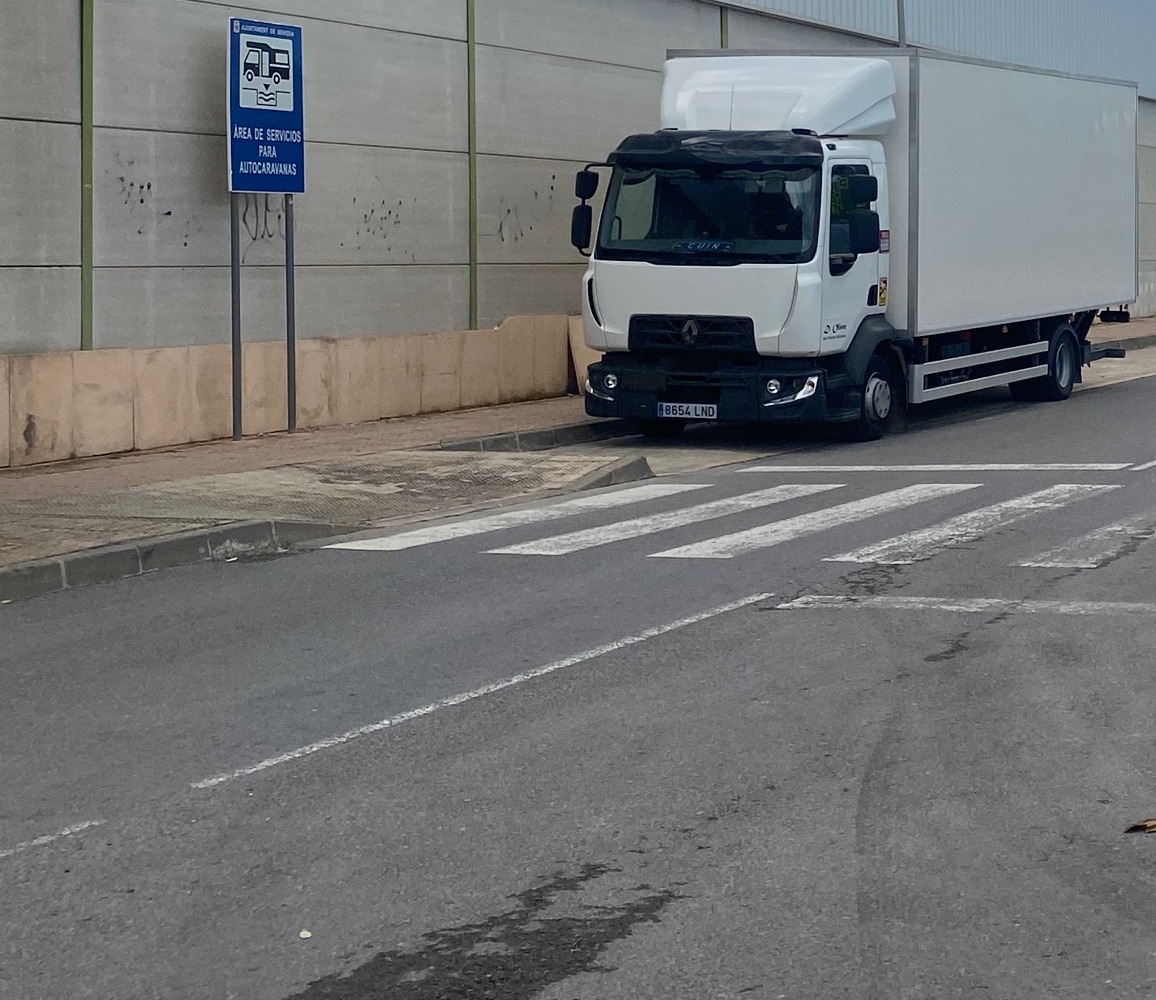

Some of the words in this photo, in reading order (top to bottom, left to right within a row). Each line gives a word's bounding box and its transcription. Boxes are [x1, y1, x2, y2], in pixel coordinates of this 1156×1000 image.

[233, 124, 252, 140] ÁREA
[254, 128, 264, 141] DE
[266, 129, 301, 143] SERVICIOS
[258, 145, 277, 158] PARA
[239, 161, 297, 176] AUTOCARAVANAS
[665, 404, 690, 416] 8654
[694, 405, 714, 417] LND
